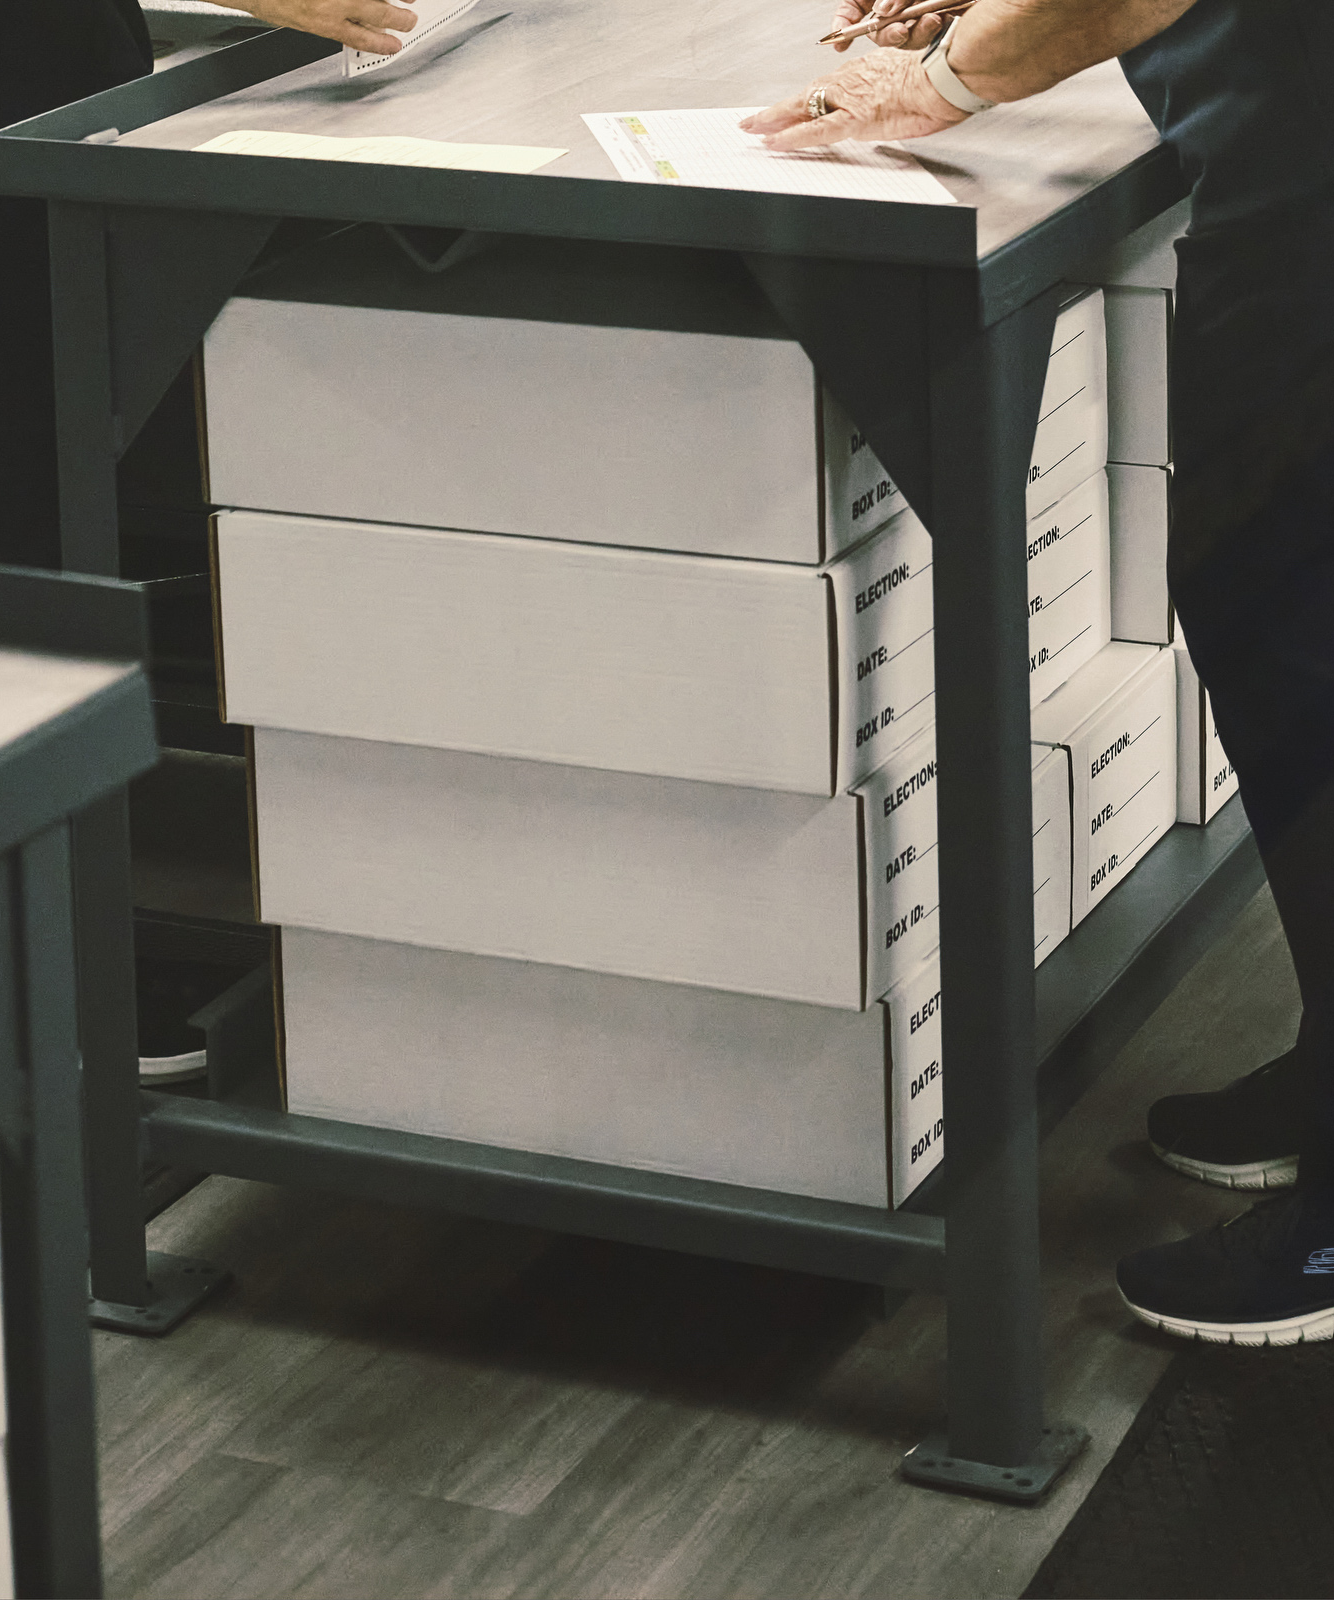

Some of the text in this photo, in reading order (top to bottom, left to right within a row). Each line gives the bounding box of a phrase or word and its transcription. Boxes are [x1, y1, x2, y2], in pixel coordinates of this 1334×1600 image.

[1028, 465, 1040, 485] ID:
[852, 480, 891, 520] BOX ID:
[1026, 525, 1060, 563] ECTION:
[854, 561, 910, 614] ELECTION:
[856, 645, 888, 681] DATE:
[1039, 647, 1050, 665] ID:
[855, 706, 895, 749] BOX ID:
[1091, 731, 1131, 780] ELECTION:
[883, 760, 938, 818] ELECTION:
[1091, 803, 1114, 836] DATE:
[885, 845, 917, 884] DATE:
[1090, 853, 1119, 892] BOX ID:
[885, 904, 924, 950] BOX ID:
[910, 990, 942, 1036] ELECT
[910, 1059, 940, 1100] DATE:
[910, 1117, 944, 1165] BOX ID
